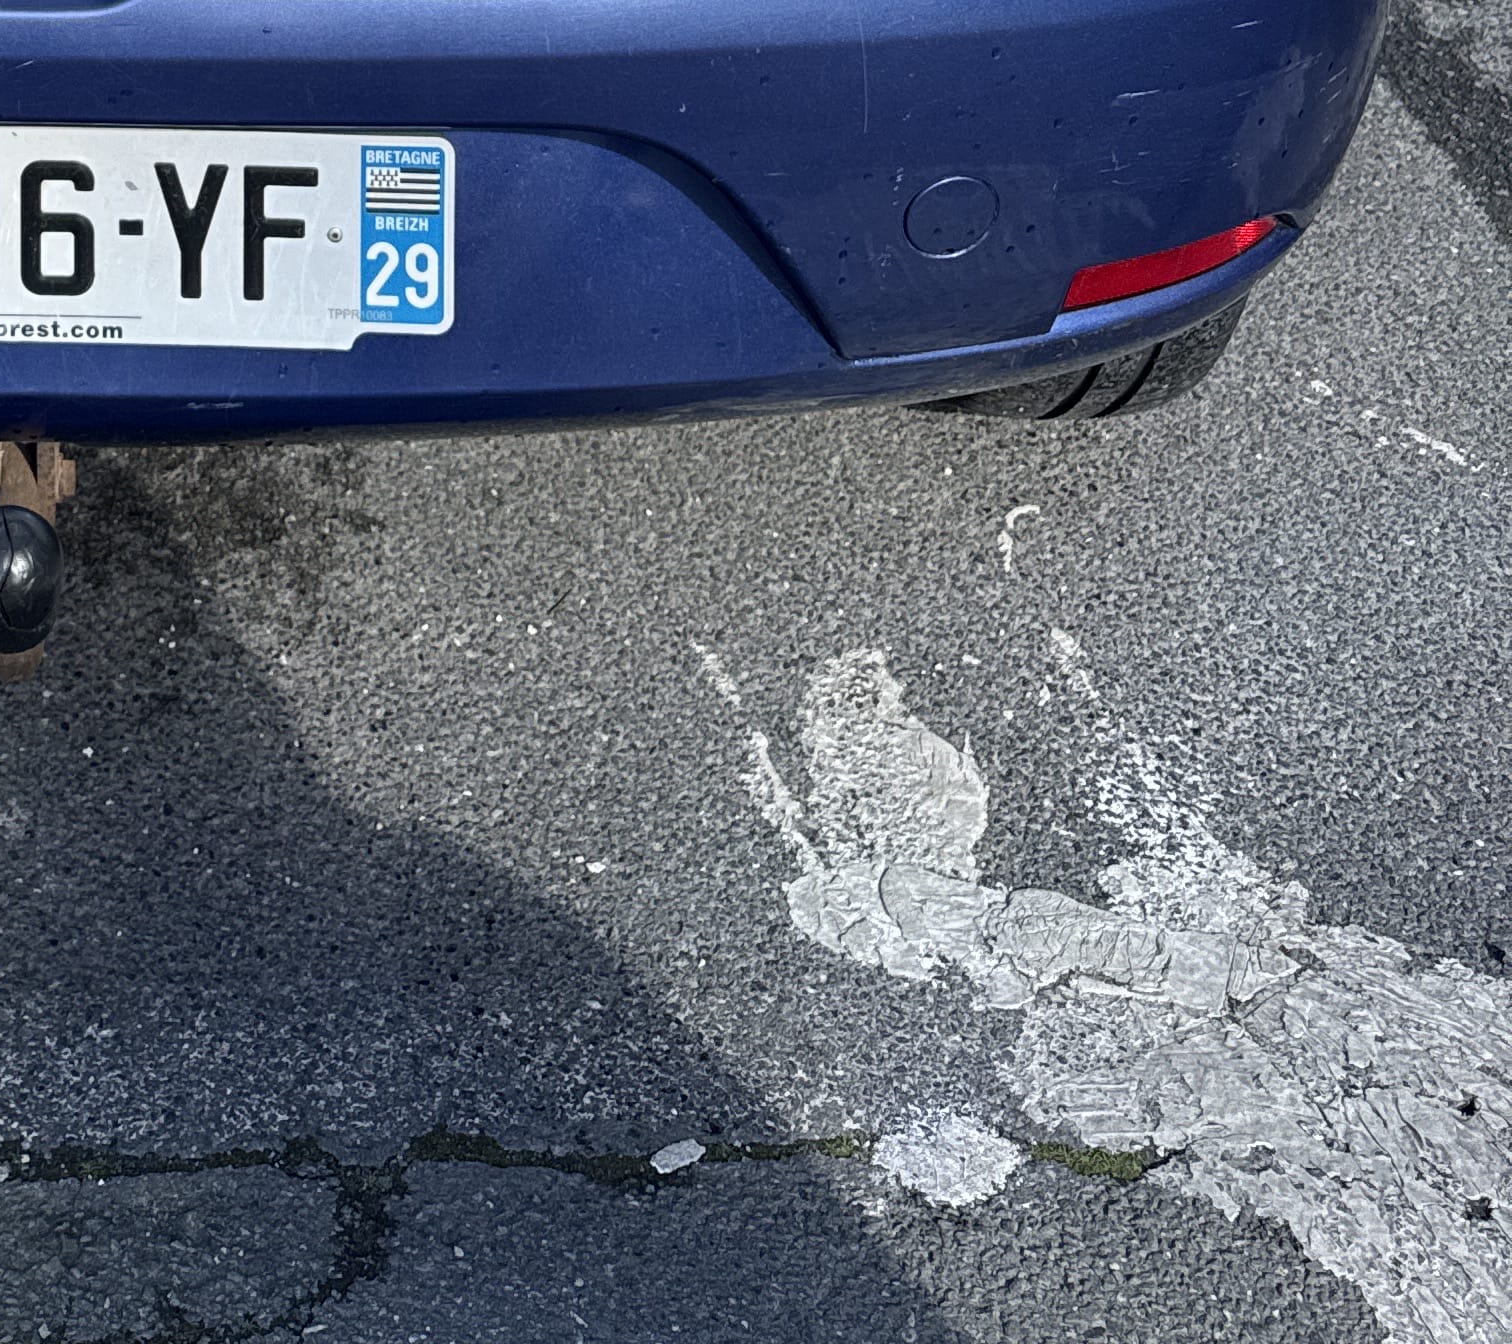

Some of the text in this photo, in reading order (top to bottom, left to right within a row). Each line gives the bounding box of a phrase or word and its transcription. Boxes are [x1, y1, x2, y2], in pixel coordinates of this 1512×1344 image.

[365, 149, 441, 165] BRETAGNE
[375, 216, 429, 232] BREIZH
[365, 241, 439, 309] 29
